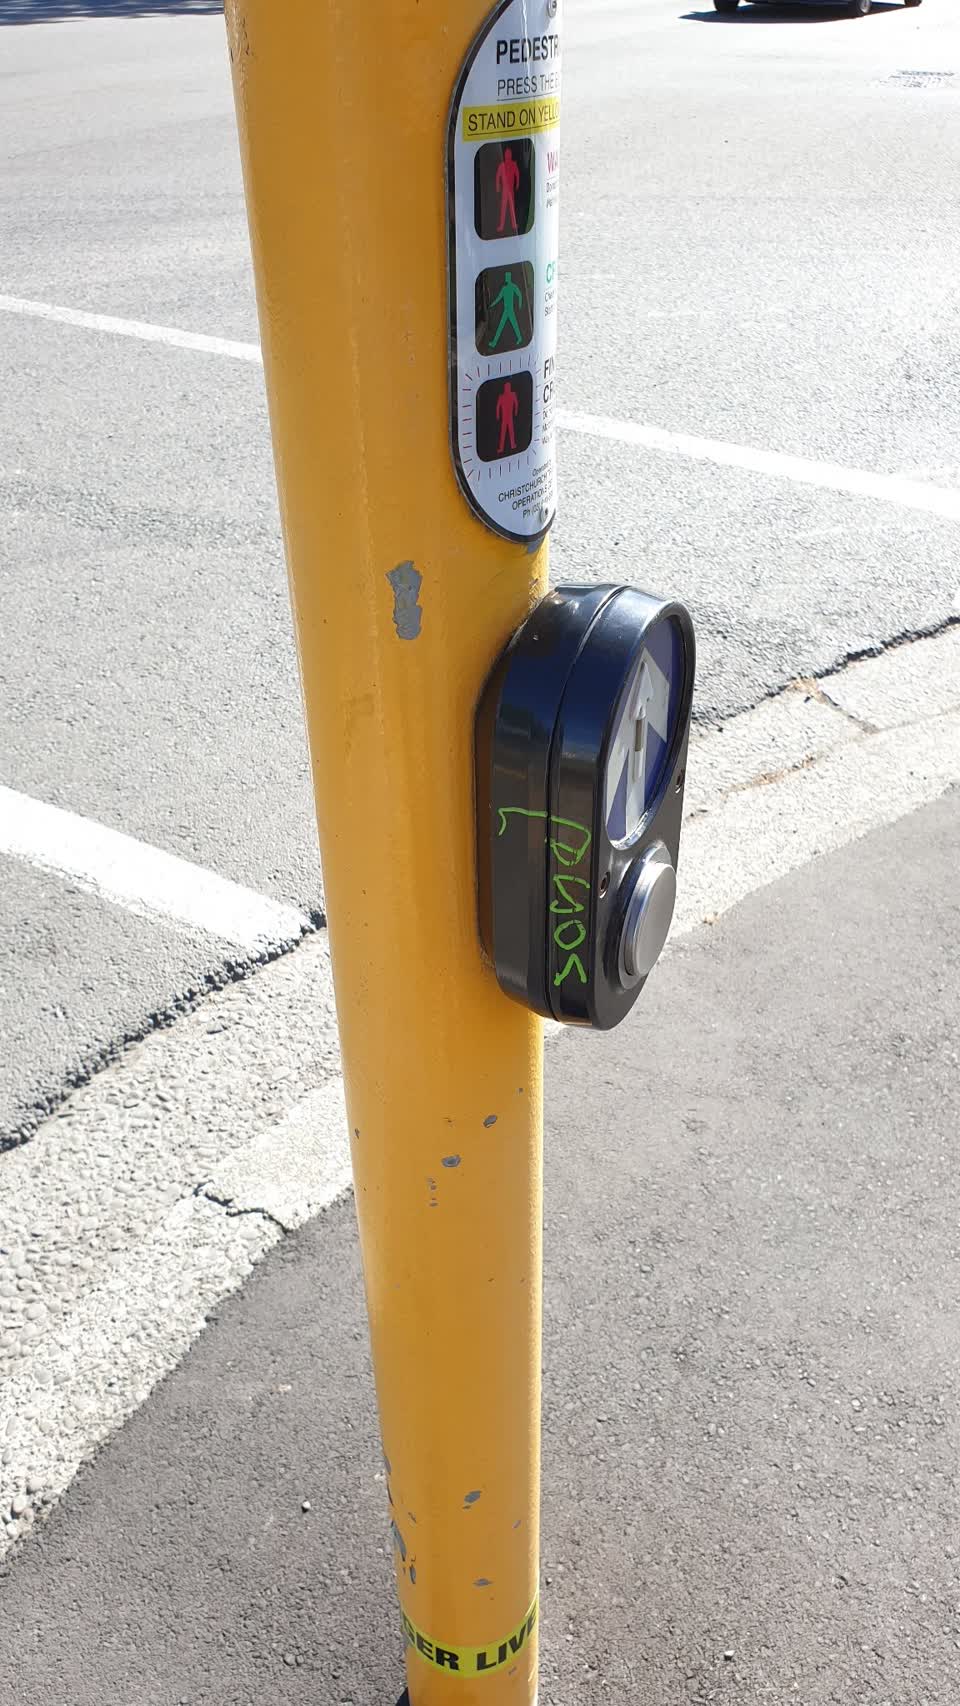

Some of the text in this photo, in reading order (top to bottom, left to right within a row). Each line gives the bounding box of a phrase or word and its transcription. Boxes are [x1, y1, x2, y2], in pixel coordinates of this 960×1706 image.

[497, 75, 537, 97] PRESS
[540, 72, 555, 92] THE
[468, 111, 515, 132] STAND
[519, 108, 535, 126] ON
[498, 472, 548, 503] CHRISTCHURCH
